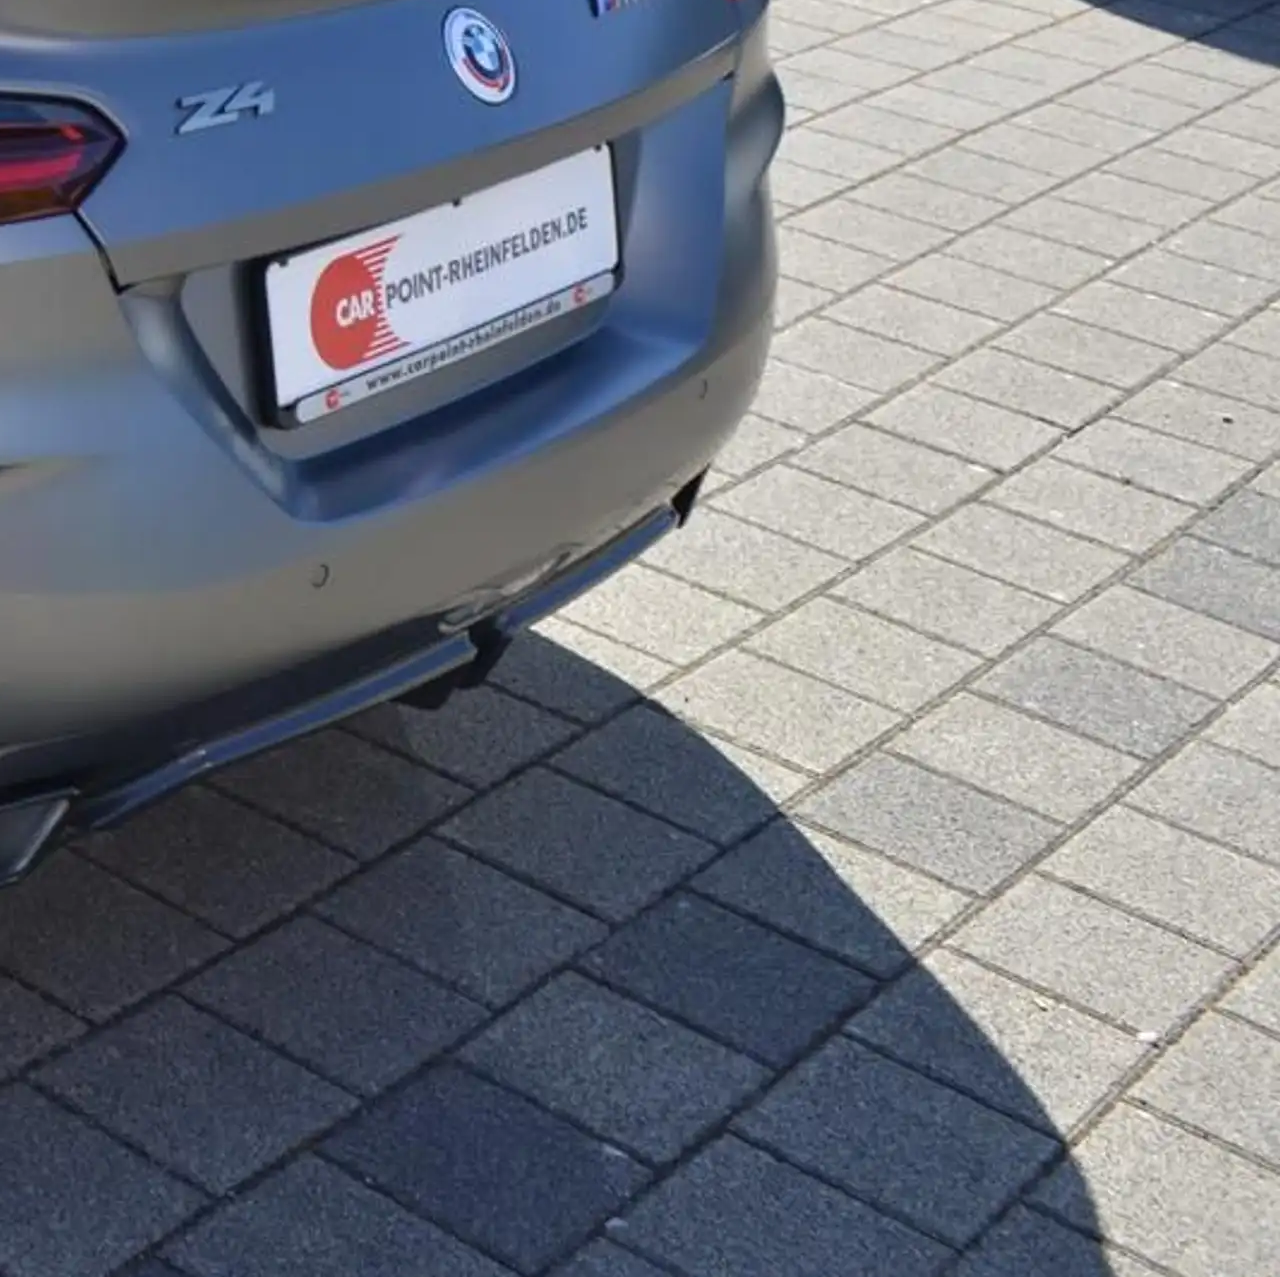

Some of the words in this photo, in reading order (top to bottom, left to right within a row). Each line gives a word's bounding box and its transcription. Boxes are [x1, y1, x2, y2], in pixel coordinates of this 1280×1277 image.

[174, 80, 275, 135] Z4
[334, 290, 375, 327] CAR
[386, 206, 589, 309] POINT-RHEINFELDEN.DE
